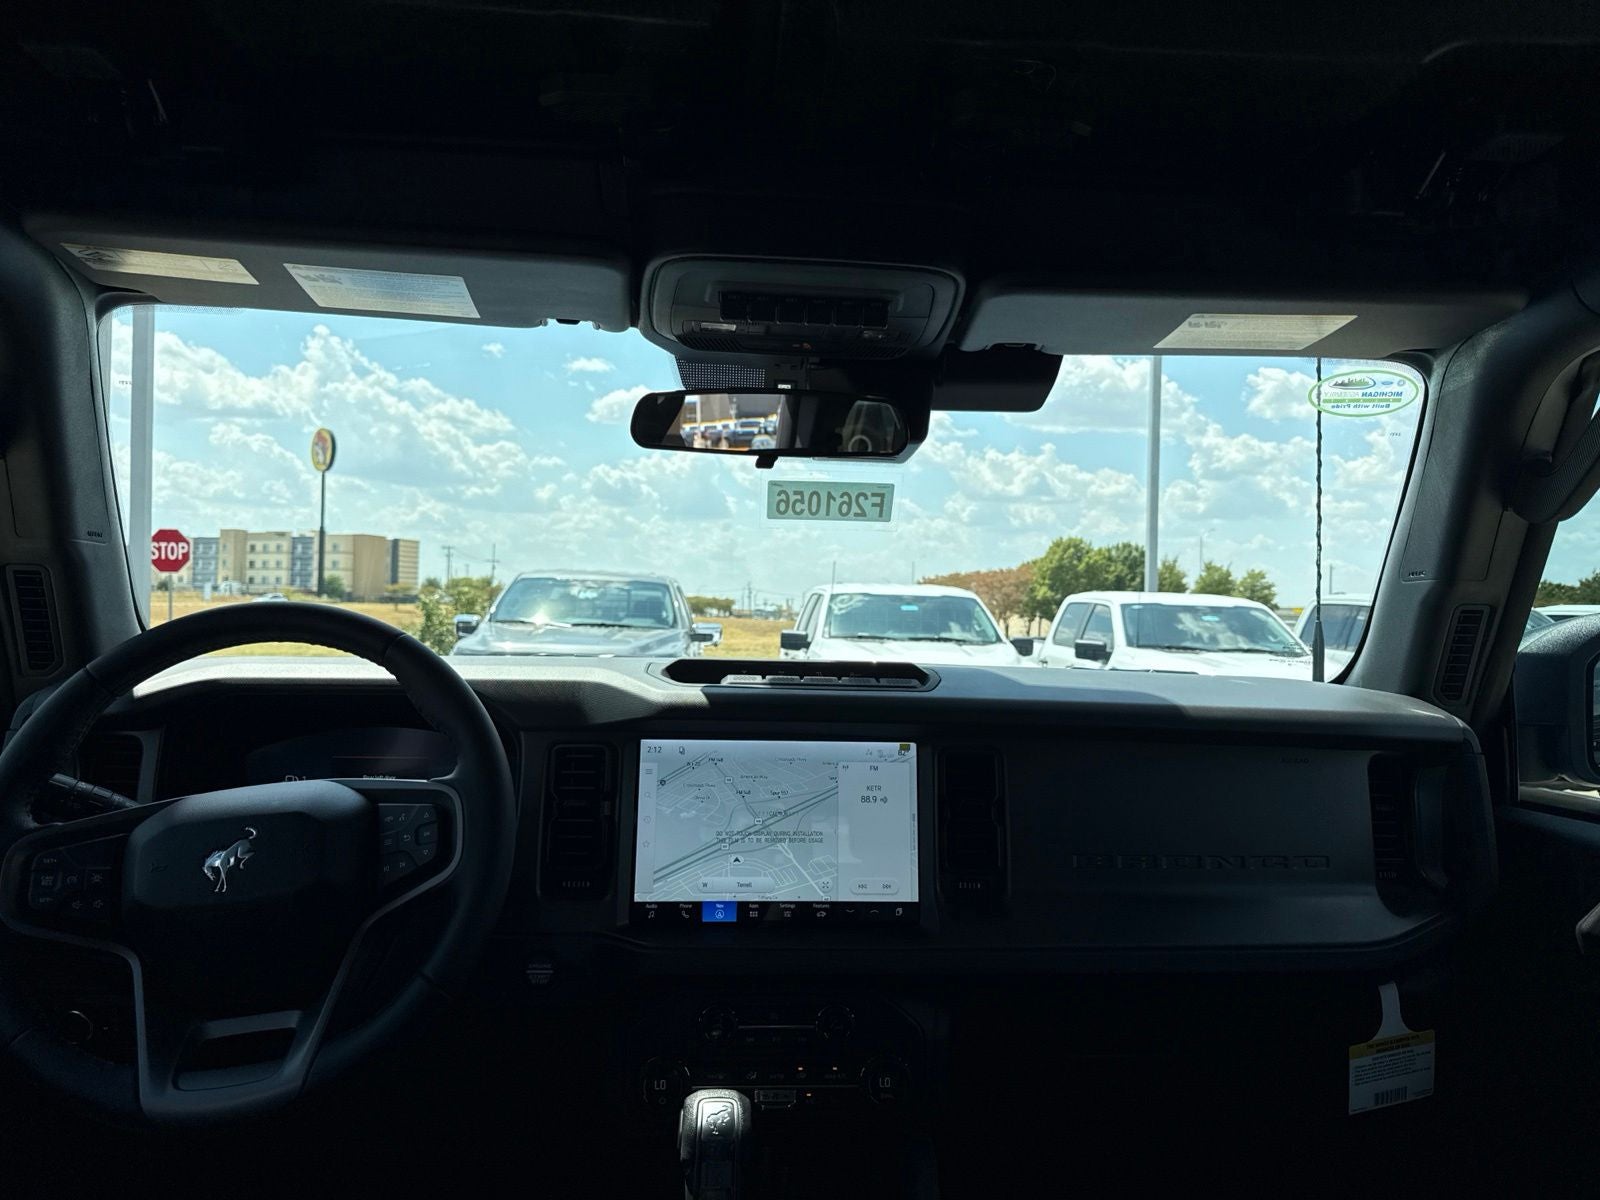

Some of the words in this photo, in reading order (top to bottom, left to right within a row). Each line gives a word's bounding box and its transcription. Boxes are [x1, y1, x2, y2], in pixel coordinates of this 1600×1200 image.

[151, 541, 188, 560] STOP
[647, 746, 662, 754] 2:12
[866, 784, 882, 792] KETR
[860, 795, 878, 804] 88.9
[1072, 853, 1331, 870] BRONCO
[654, 1079, 667, 1091] LO
[879, 1077, 891, 1088] LO
